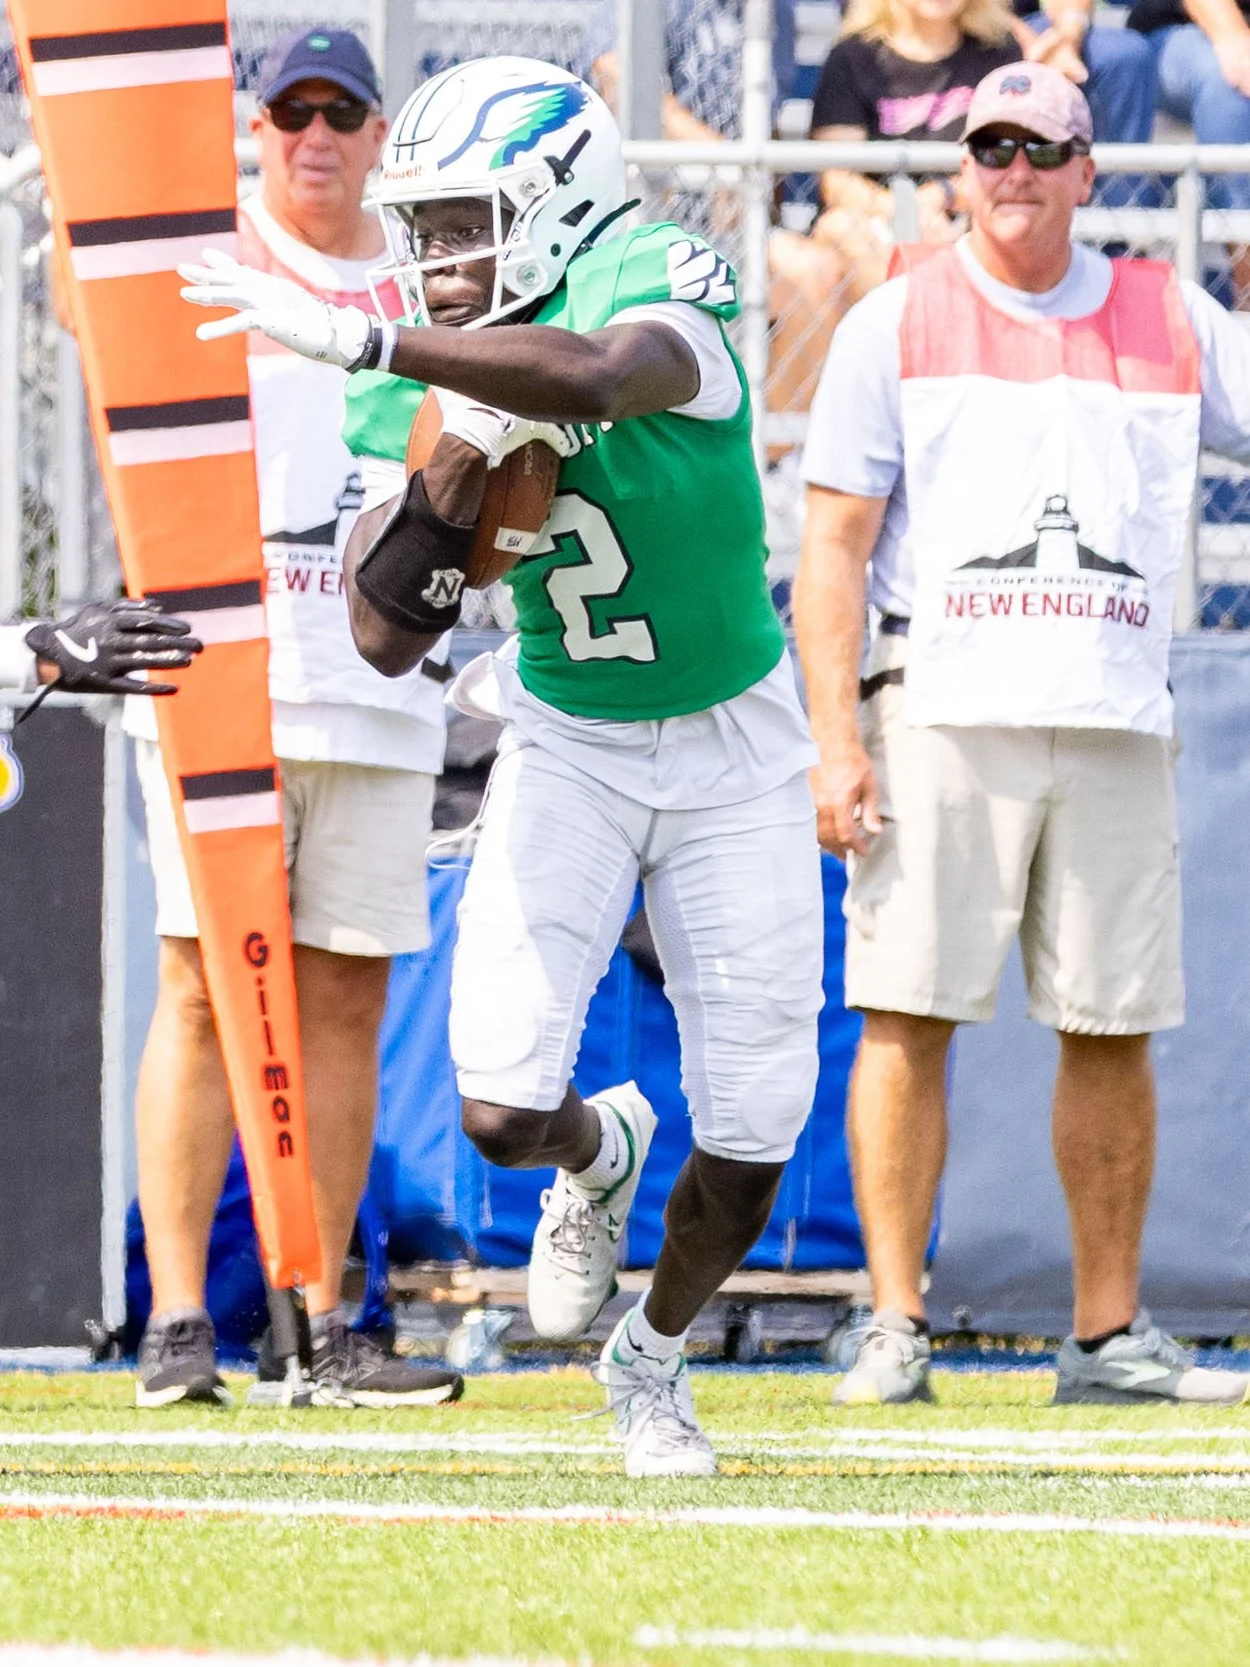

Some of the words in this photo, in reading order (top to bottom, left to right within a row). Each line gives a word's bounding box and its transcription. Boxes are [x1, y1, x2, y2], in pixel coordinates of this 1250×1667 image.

[267, 567, 311, 593] EW
[521, 488, 660, 665] 2
[945, 592, 1013, 618] NEW
[1022, 592, 1150, 628] ENGLAND
[244, 931, 293, 1157] Gilman
